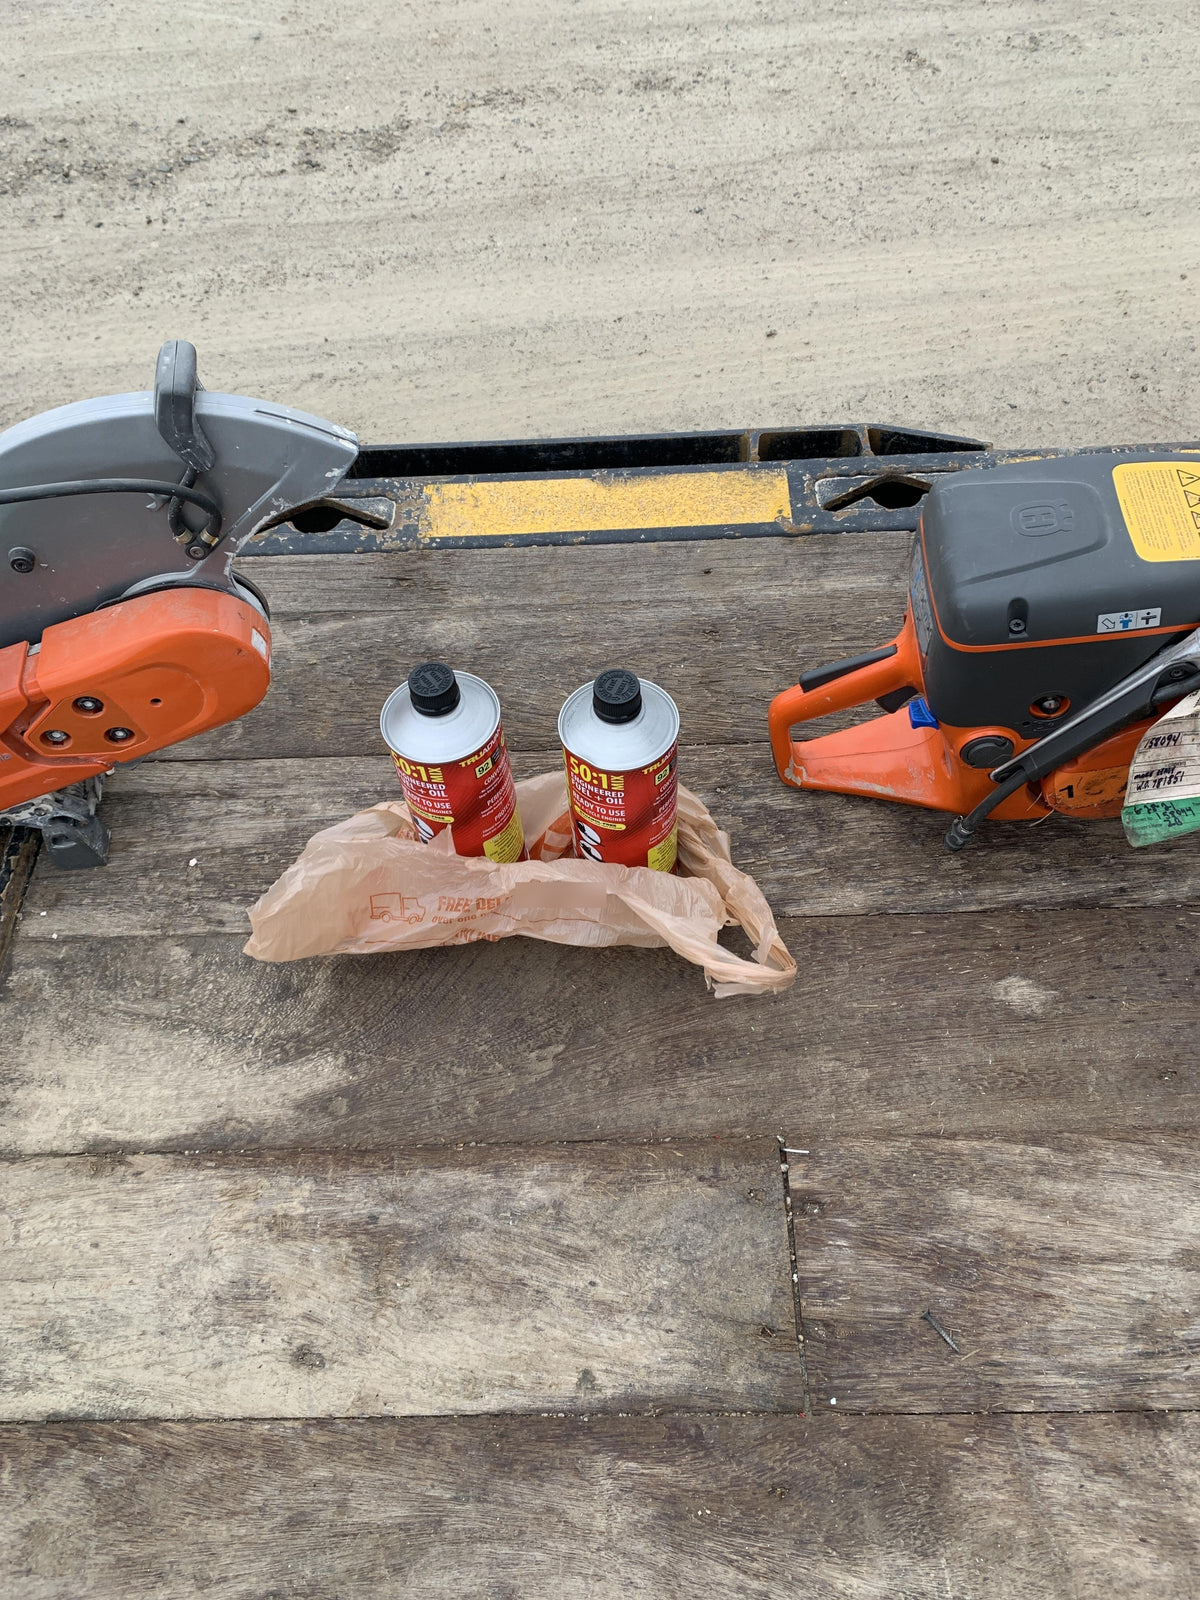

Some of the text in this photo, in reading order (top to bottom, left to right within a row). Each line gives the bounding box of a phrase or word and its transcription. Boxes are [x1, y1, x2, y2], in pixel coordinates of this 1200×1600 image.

[391, 750, 428, 782] 50:1
[478, 762, 490, 775] 92
[570, 756, 608, 790] 50:1
[427, 767, 445, 783] MIX
[611, 775, 625, 791] MIX
[571, 771, 625, 798] ENGINEERED
[572, 777, 593, 799] FUEL
[606, 797, 625, 805] OIL
[429, 790, 448, 798] OIL
[420, 799, 432, 807] TO
[434, 802, 452, 810] USE
[573, 790, 626, 817] READY TO USE
[437, 896, 472, 913] FREE
[457, 914, 477, 923] one
